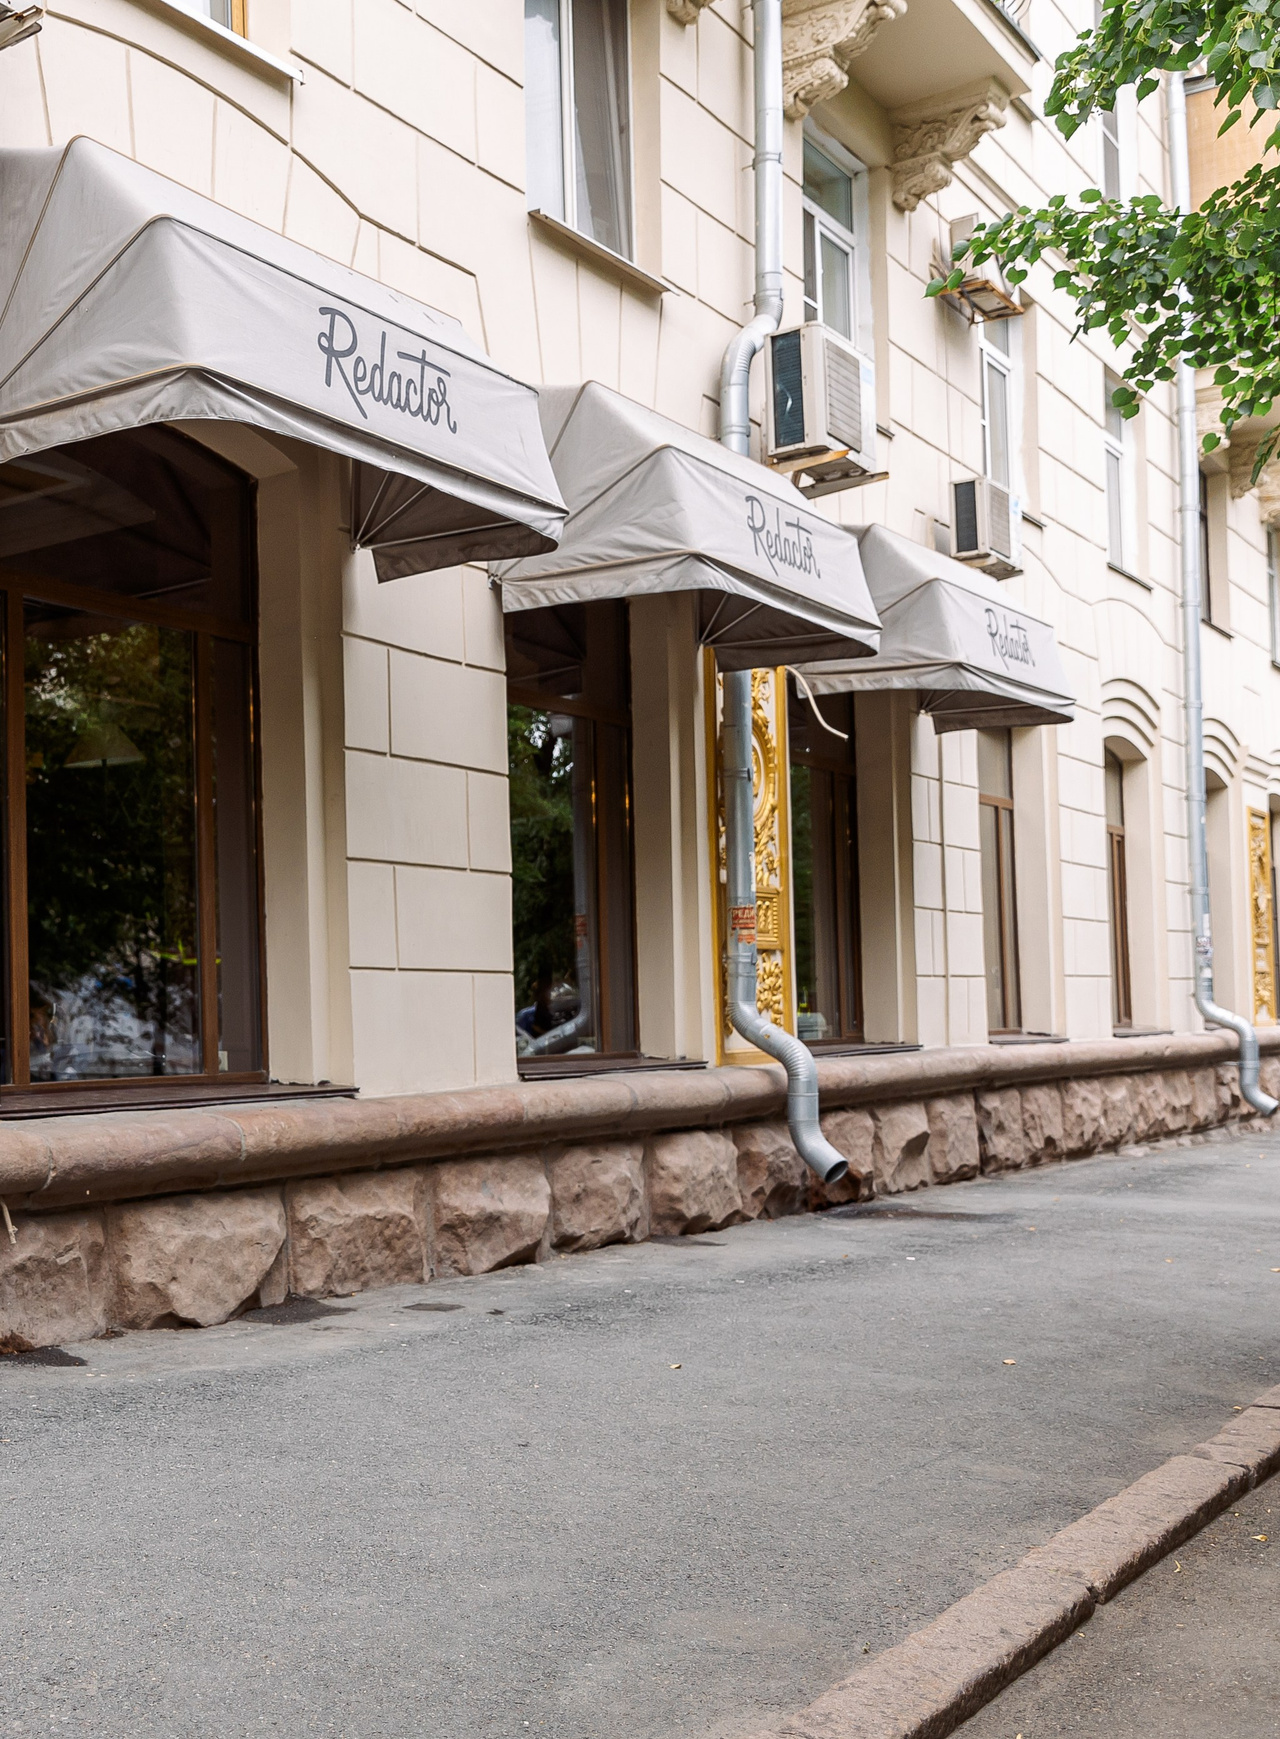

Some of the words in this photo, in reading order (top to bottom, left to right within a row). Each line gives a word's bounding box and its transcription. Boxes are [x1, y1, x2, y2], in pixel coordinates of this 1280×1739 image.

[317, 306, 457, 434] Redactor
[745, 495, 821, 579] Redactor
[985, 608, 1036, 671] Redactor
